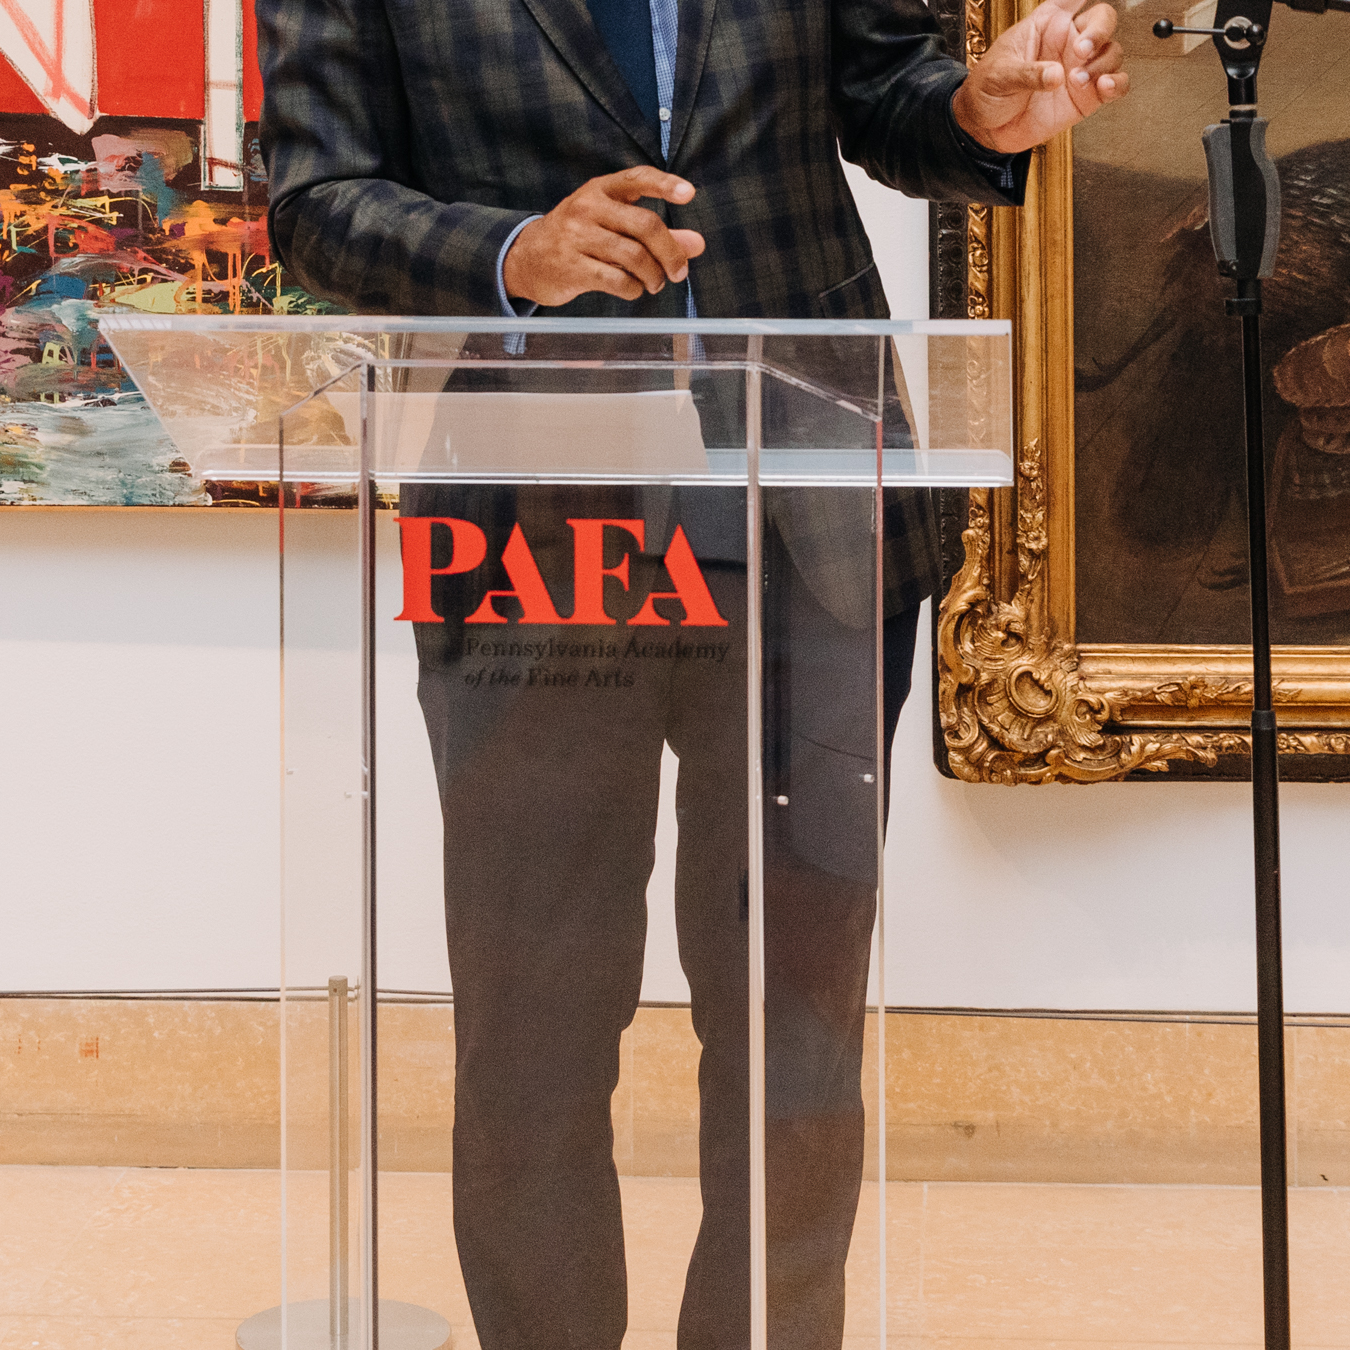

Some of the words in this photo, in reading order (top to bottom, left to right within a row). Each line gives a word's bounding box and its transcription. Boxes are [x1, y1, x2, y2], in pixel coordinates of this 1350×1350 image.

[393, 516, 729, 627] PAFA
[466, 637, 617, 661] Pennsylvania
[624, 635, 730, 663] Academy
[464, 666, 486, 688] of
[490, 668, 520, 686] the
[527, 668, 580, 687] Fine
[584, 667, 635, 688] Arts
